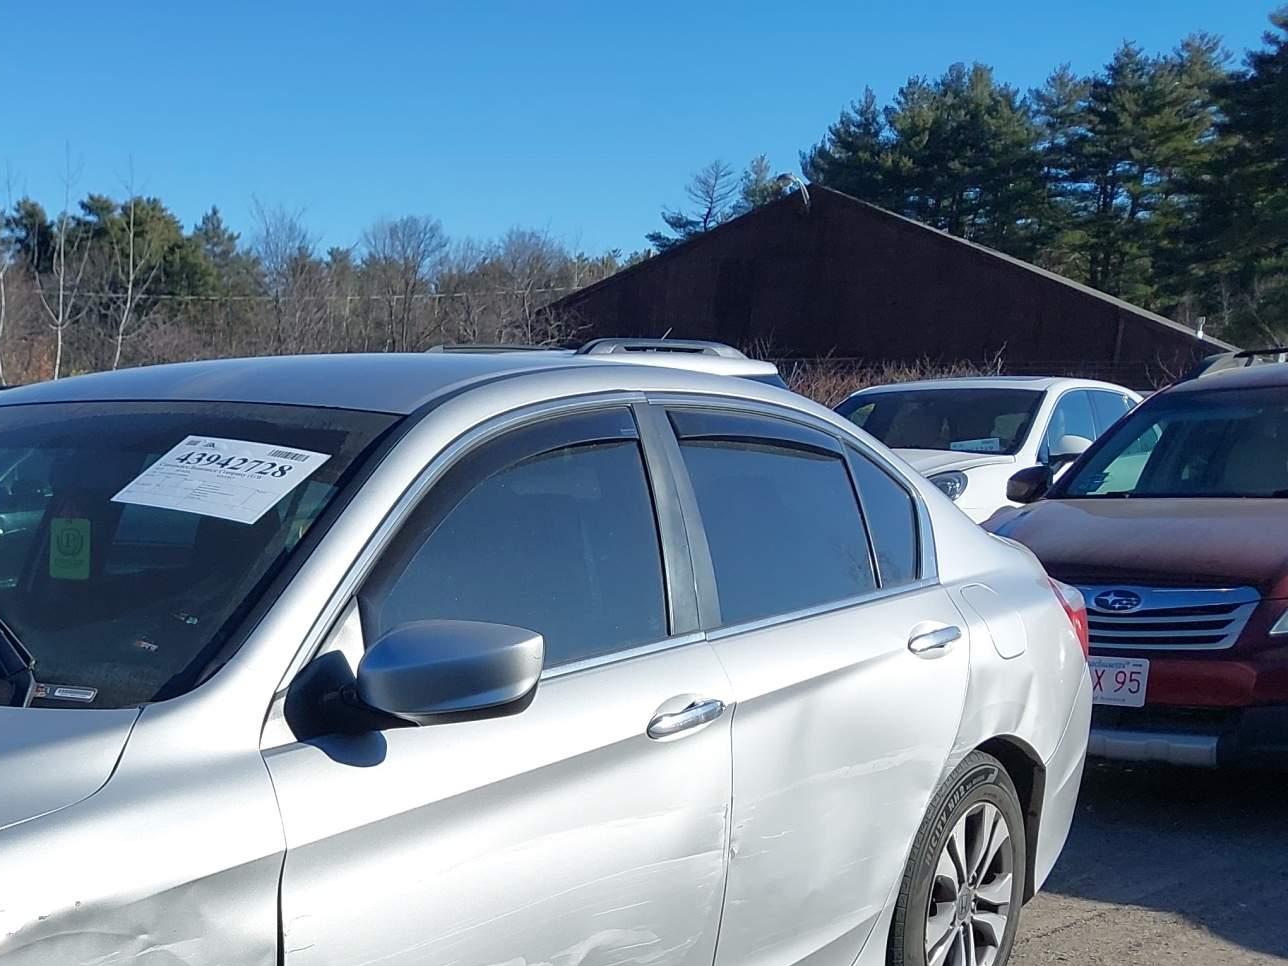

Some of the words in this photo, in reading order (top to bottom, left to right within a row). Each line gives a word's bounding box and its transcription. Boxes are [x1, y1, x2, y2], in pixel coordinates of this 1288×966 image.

[176, 450, 294, 479] 43942728
[1092, 668, 1106, 692] X
[1113, 670, 1142, 694] 95
